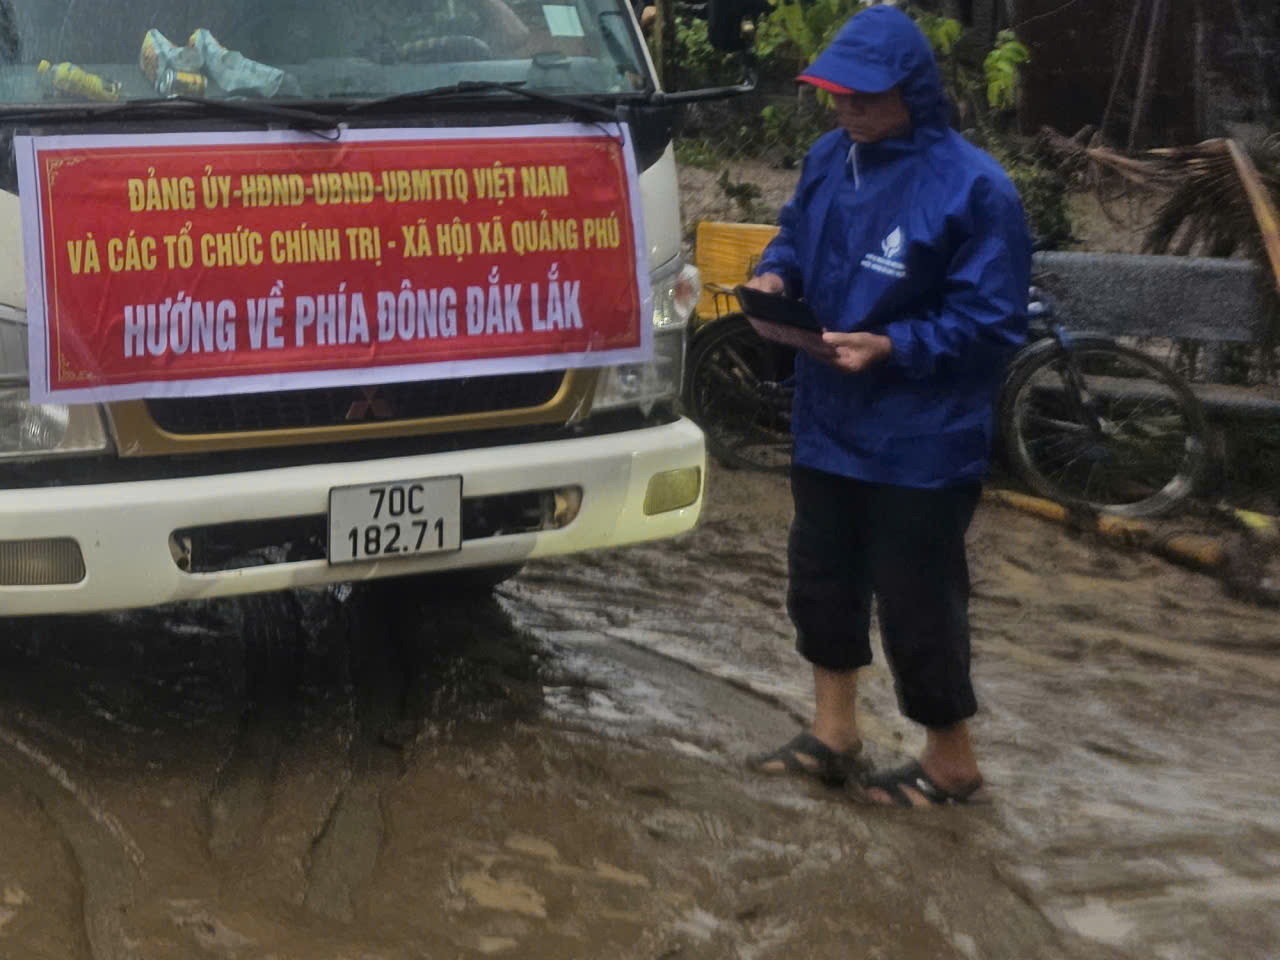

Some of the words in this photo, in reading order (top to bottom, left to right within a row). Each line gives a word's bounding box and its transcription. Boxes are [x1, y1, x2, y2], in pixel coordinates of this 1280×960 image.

[128, 166, 196, 212] ĐẢNG
[472, 160, 516, 206] VIỆT
[521, 165, 569, 198] NAM
[66, 232, 101, 274] VÀ
[108, 230, 157, 272] CÁC
[163, 221, 194, 269] TỔ
[201, 225, 264, 267] CHỨC
[270, 222, 341, 264] CHÍNH
[345, 227, 382, 266] TRỊ
[401, 218, 432, 258] XÃ
[436, 216, 473, 263] HỘI
[477, 216, 507, 254] XÃ
[511, 209, 579, 256] QUẢNG
[583, 211, 620, 249] PHÚ
[123, 291, 237, 358] HƯỚNG
[246, 279, 285, 350] VỀ
[295, 282, 370, 347] PHÍA
[377, 279, 457, 342] ĐÔNG
[466, 266, 524, 337] ĐẮK
[531, 262, 584, 331] LẮK
[369, 484, 425, 519] 70C
[348, 517, 444, 558] 182.71
